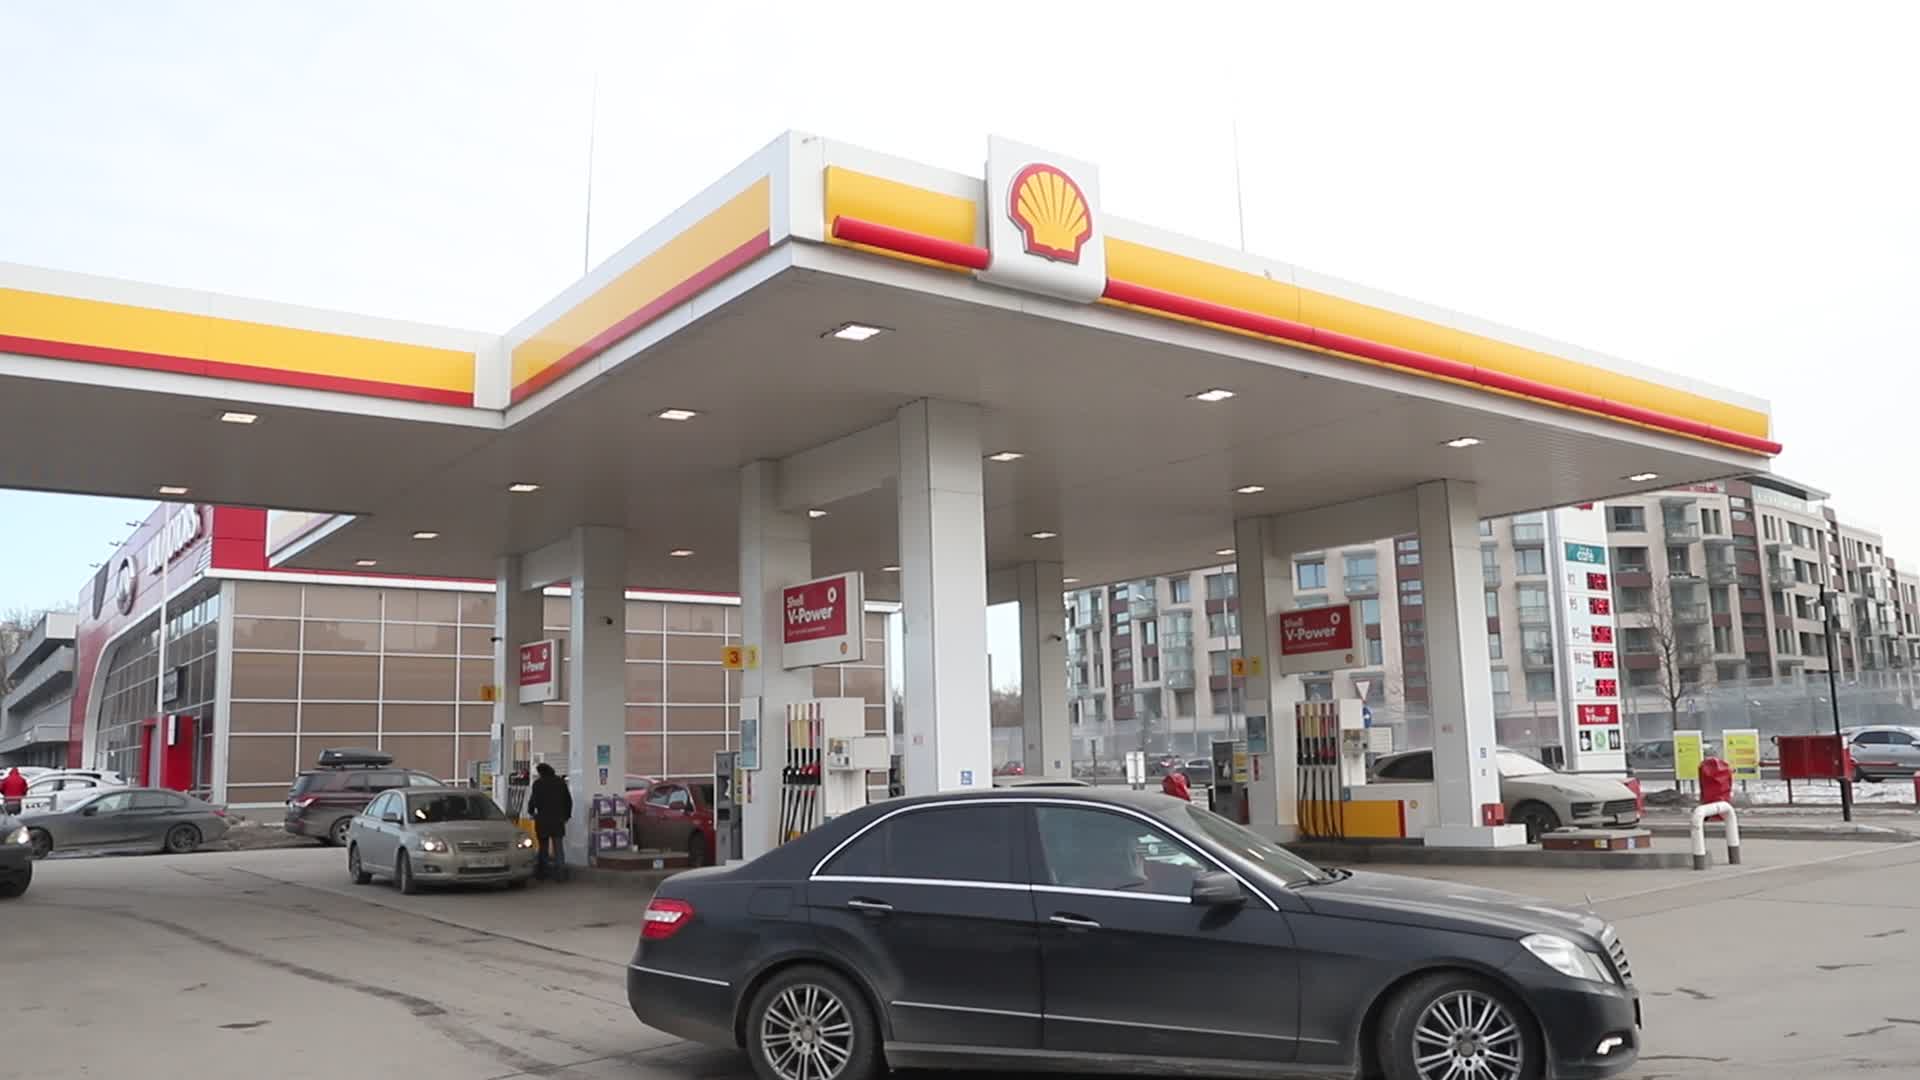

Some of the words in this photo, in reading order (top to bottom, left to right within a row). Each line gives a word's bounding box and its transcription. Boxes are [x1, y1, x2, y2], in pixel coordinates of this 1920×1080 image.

[786, 594, 804, 608] Shell
[787, 606, 833, 624] V-Power
[1285, 627, 1337, 641] V-Power
